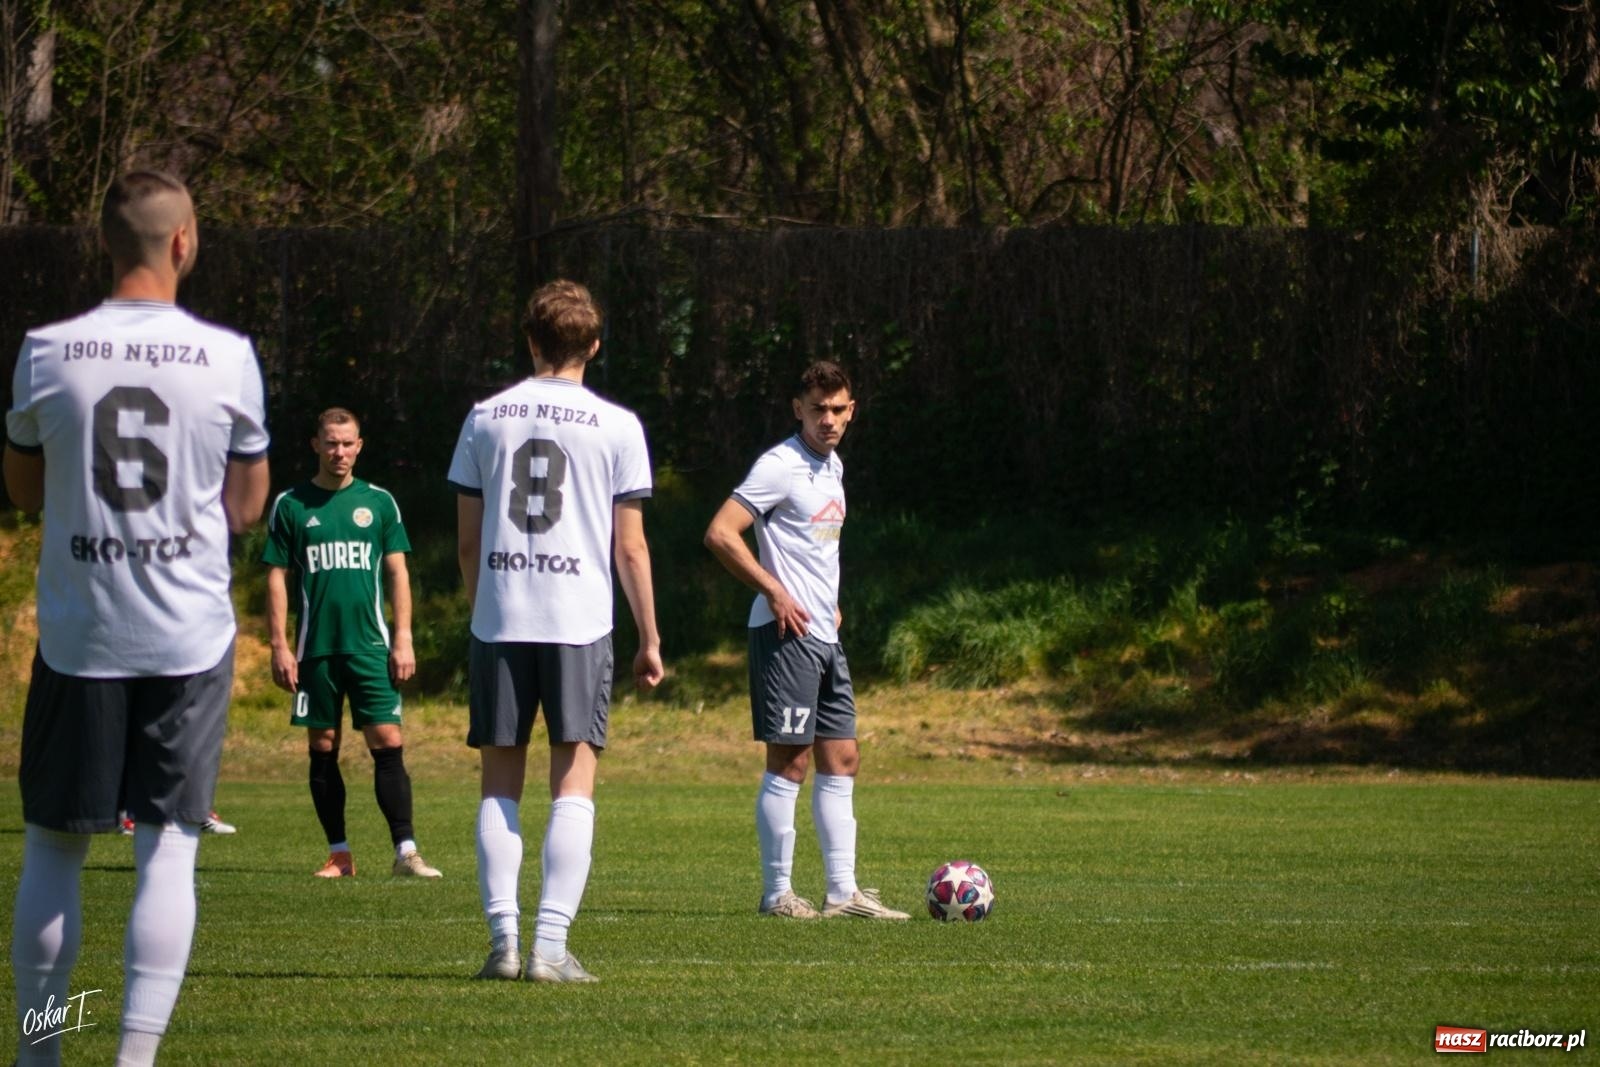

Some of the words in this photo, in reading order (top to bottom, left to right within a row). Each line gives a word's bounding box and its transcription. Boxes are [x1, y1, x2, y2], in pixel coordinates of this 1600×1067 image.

[64, 341, 113, 361] 1908
[124, 343, 210, 368] NĘDZA
[492, 404, 529, 421] 1908
[536, 404, 600, 428] NĘDZA
[93, 386, 170, 512] 6
[508, 438, 567, 535] 8
[306, 541, 372, 574] BUREK
[781, 707, 811, 734] 17
